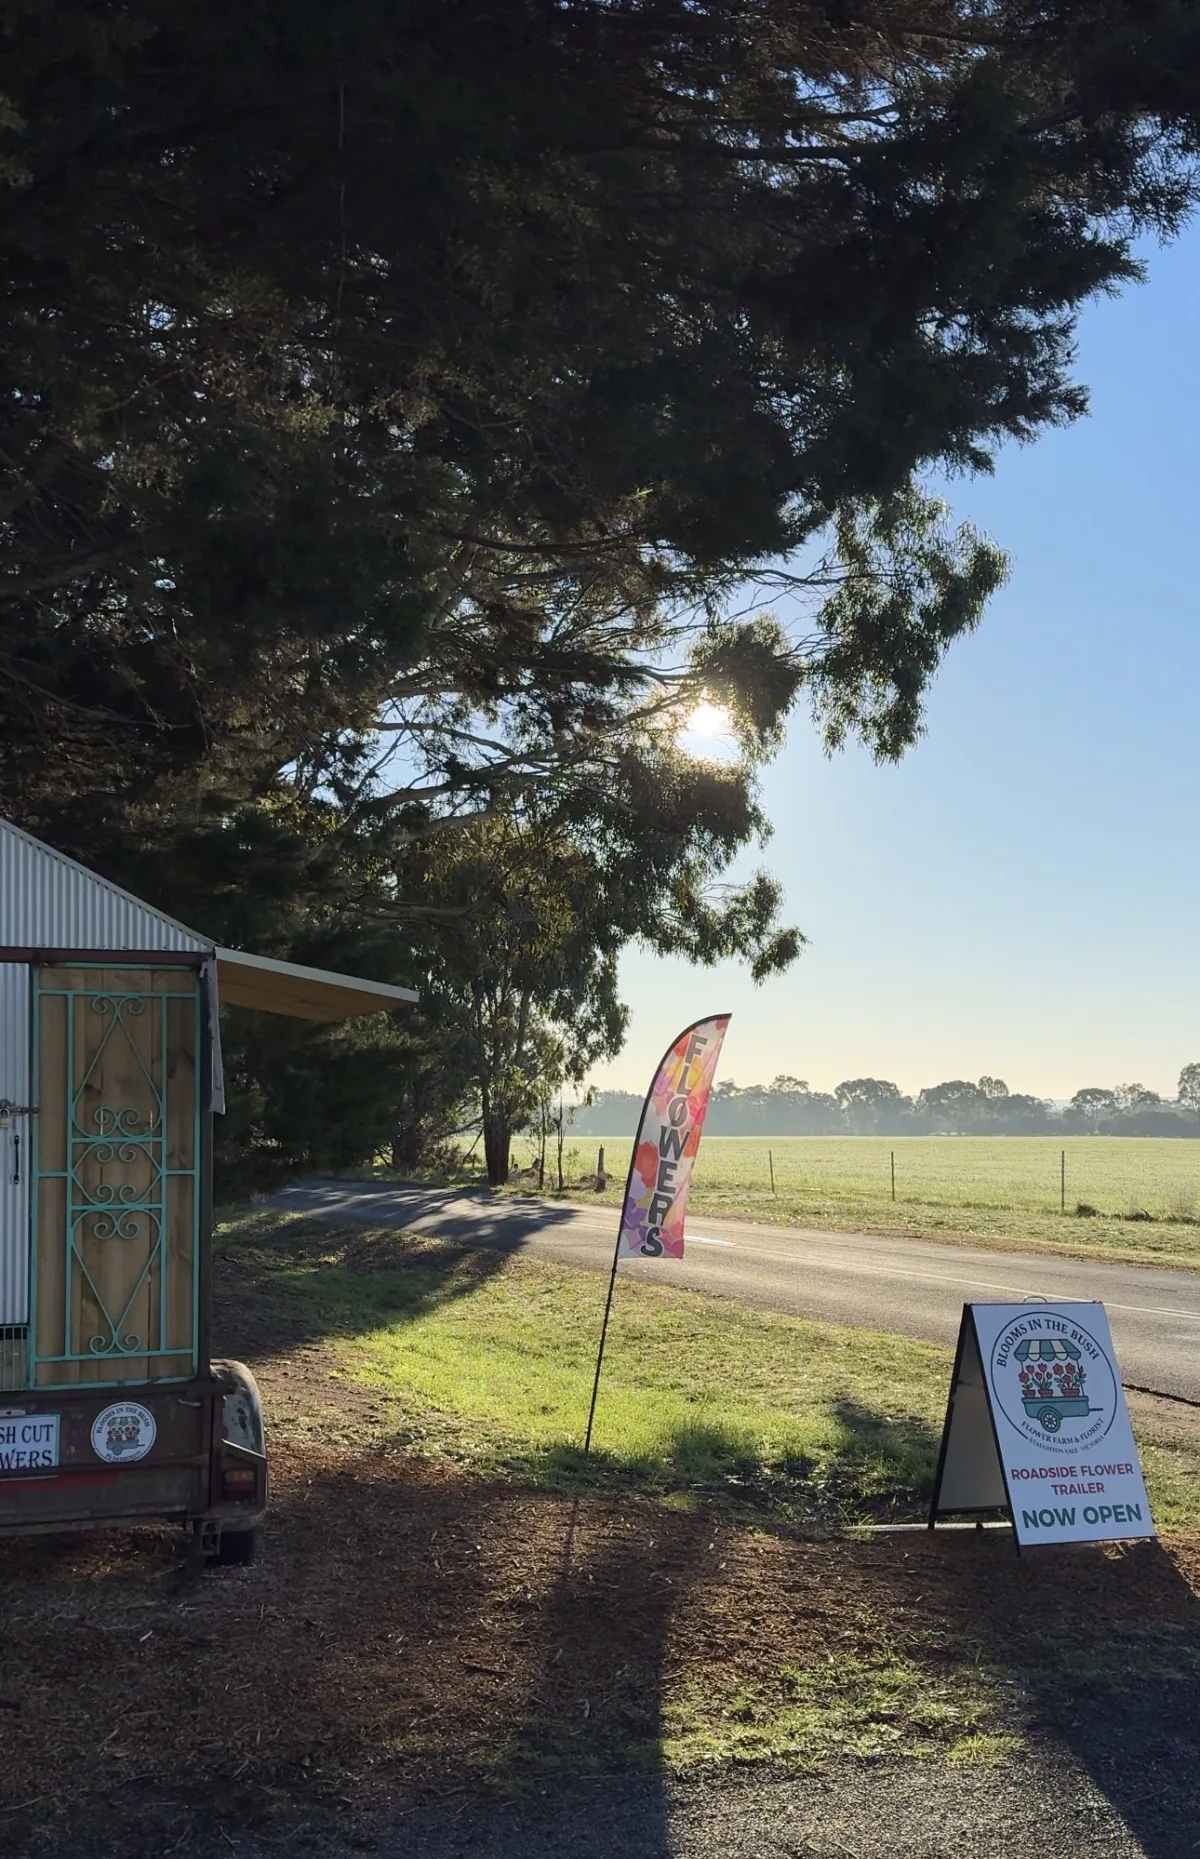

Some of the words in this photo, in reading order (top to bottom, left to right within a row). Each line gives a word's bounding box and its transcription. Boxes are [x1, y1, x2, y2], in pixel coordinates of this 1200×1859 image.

[641, 1034, 708, 1258] FLOWERS
[997, 1323, 1028, 1367] BLOOMS
[1027, 1318, 1042, 1331] IN
[1044, 1318, 1068, 1334] THE
[1070, 1329, 1100, 1360] BUSH
[21, 1423, 54, 1443] CUT
[96, 1410, 116, 1433] BLOOMS
[138, 1411, 151, 1427] BUSH
[1021, 1420, 1052, 1442] FLOWER
[1052, 1436, 1074, 1445] FARM
[1080, 1416, 1104, 1441] FLORIST
[1011, 1465, 1078, 1481] ROADSIDE
[1081, 1463, 1134, 1477] FLOWER
[1051, 1482, 1105, 1496] TRAILER
[1021, 1507, 1076, 1529] NOW
[1083, 1503, 1143, 1526] OPEN
